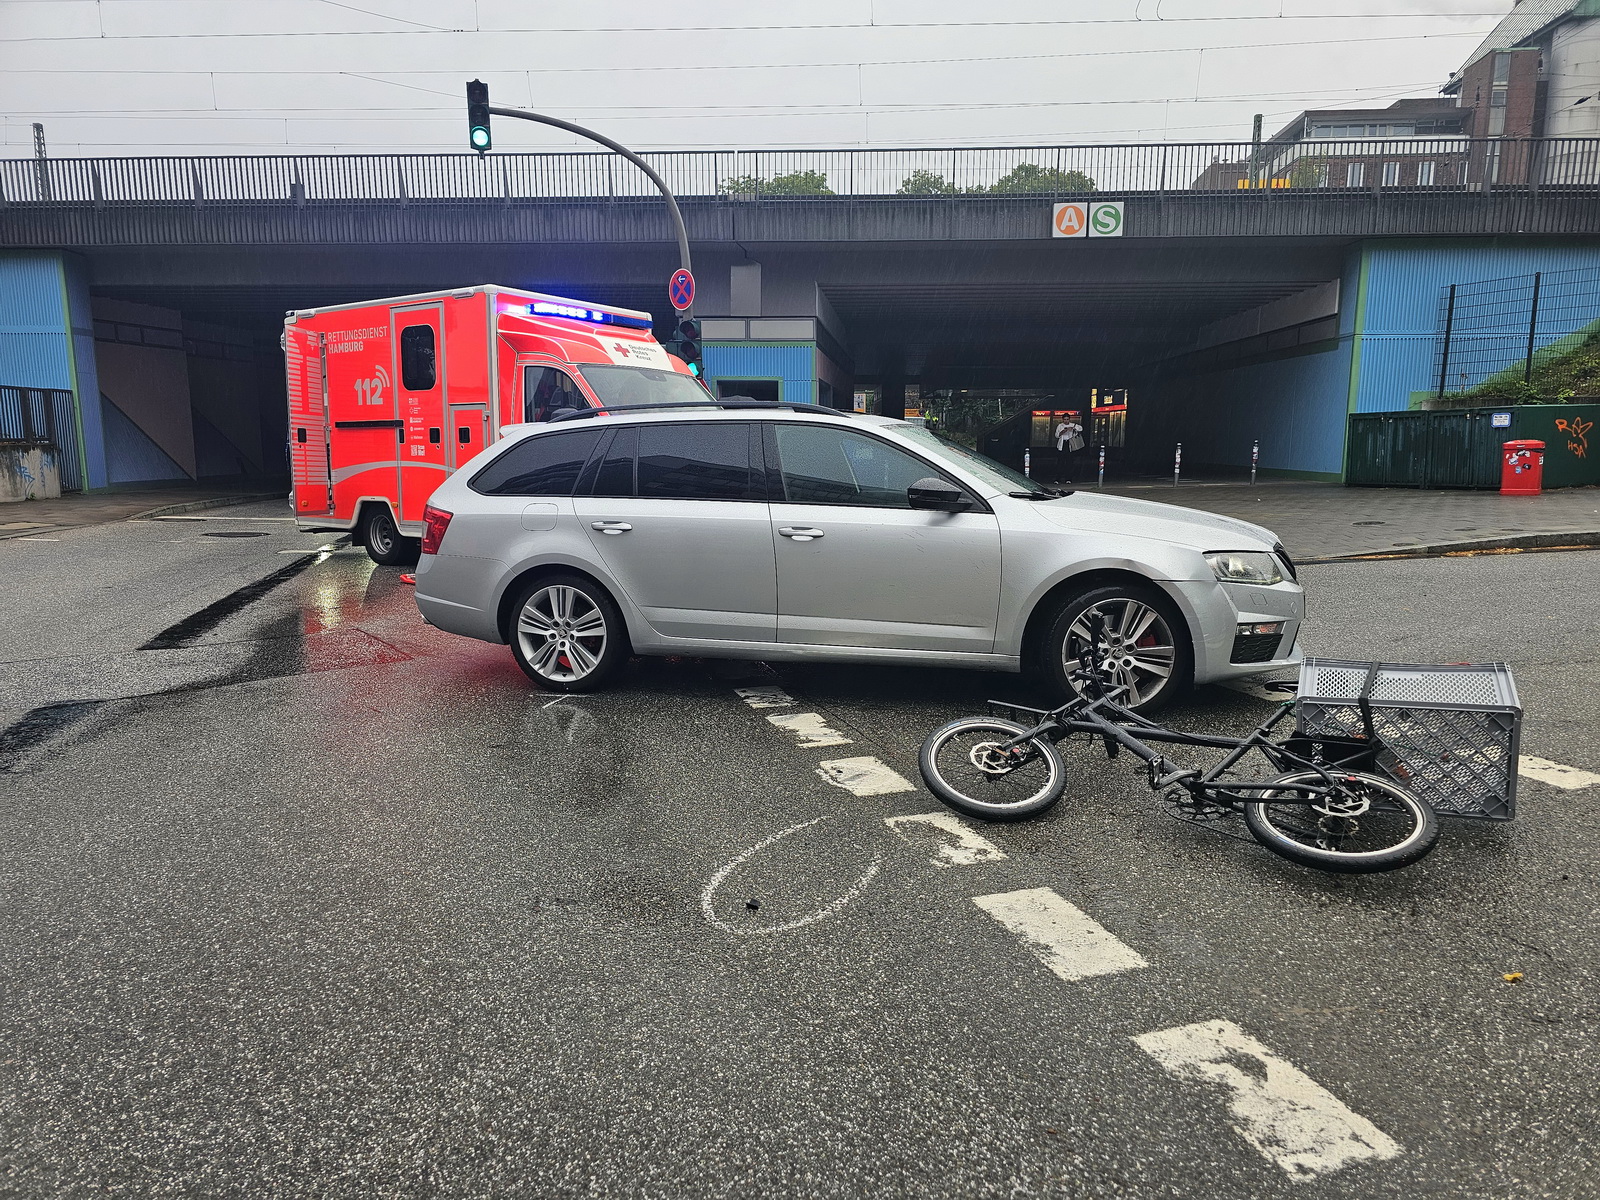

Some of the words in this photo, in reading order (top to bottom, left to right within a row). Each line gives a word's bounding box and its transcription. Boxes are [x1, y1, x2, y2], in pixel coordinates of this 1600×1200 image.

[1061, 208, 1080, 231] A
[1096, 207, 1117, 232] S
[327, 326, 388, 343] RETTUNGSDIENST
[328, 341, 364, 354] HAMBURG
[353, 378, 384, 406] 112
